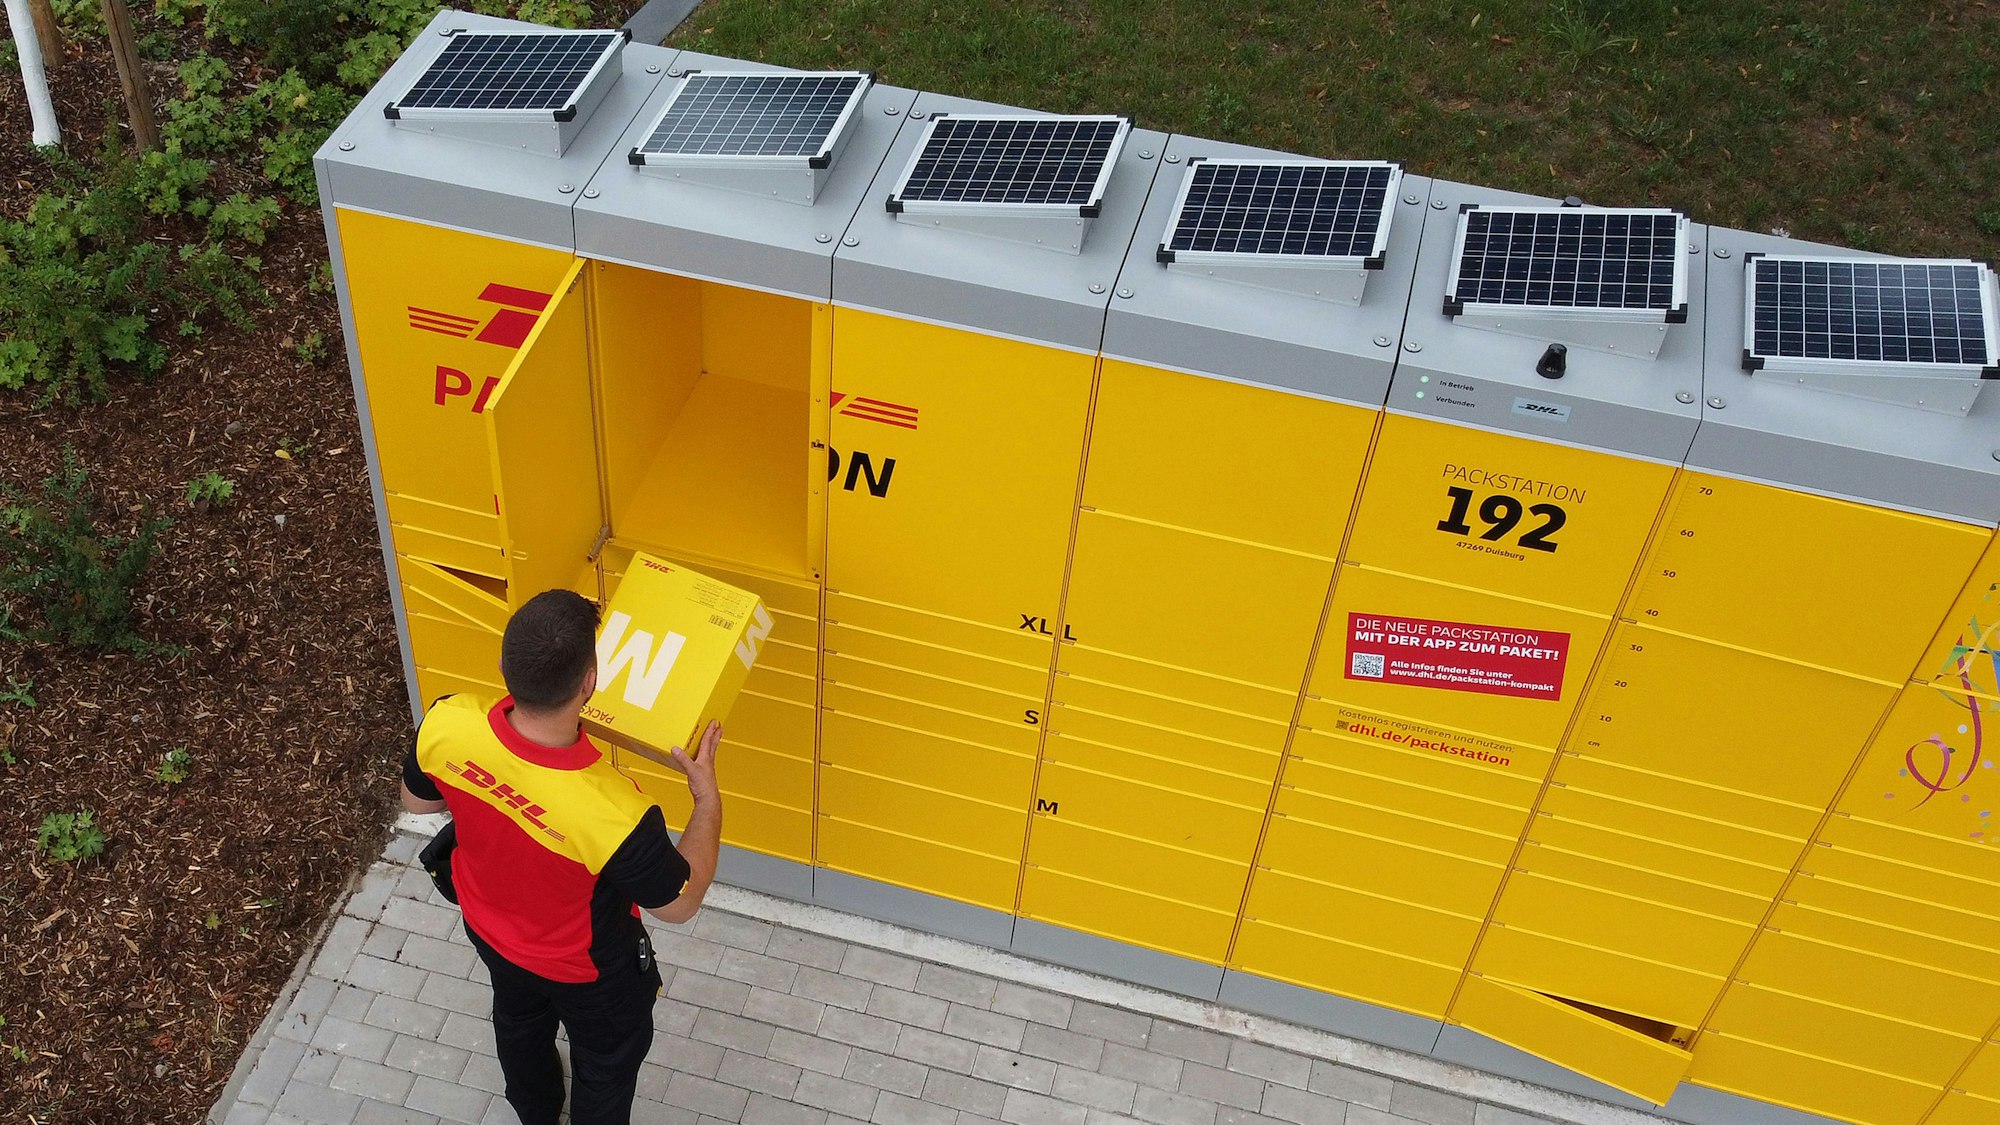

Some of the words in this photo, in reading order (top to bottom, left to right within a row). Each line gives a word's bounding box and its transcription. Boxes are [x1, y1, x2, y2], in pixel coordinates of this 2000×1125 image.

[1448, 382, 1475, 392] Betrieb
[1436, 395, 1475, 409] Verbunden
[1524, 403, 1560, 415] DHL
[1442, 463, 1587, 504] PACKSTATION
[1698, 486, 1713, 496] 70
[1436, 485, 1567, 553] 192
[1680, 528, 1694, 538] 60
[1456, 541, 1484, 552] 47269
[1485, 546, 1525, 562] Duisburg
[1662, 569, 1676, 578] 50
[1645, 608, 1659, 617] 40
[1019, 613, 1053, 635] XL
[1064, 624, 1078, 641] L
[1356, 618, 1381, 631] DIE
[1385, 621, 1428, 636] NEUE
[1431, 626, 1539, 646] PACKSTATION
[734, 602, 774, 671] M
[1355, 631, 1385, 643] MIT
[1388, 635, 1420, 647] DER
[1423, 637, 1456, 650] APP
[1458, 641, 1496, 655] ZUM
[1499, 645, 1559, 661] PAKET!
[1629, 644, 1643, 652] 30
[595, 610, 687, 712] M
[1390, 660, 1409, 670] Alle
[1411, 662, 1435, 671] Infos
[1437, 664, 1468, 675] finden
[1469, 668, 1485, 677] Sie
[1486, 671, 1513, 679] unter
[1390, 668, 1554, 692] www.dhl.de/packstation-kompakt
[1614, 680, 1627, 688] 20
[1023, 709, 1040, 725] S
[1599, 715, 1612, 723] 10
[1338, 708, 1389, 726] Kostenlos
[1390, 720, 1452, 739] registrieren
[1453, 733, 1475, 745] und
[1475, 738, 1515, 753] nutzen:
[1349, 723, 1510, 766] dhl.de/packstation
[1588, 740, 1600, 748] cm
[460, 760, 548, 830] DHL
[1036, 798, 1059, 815] M
